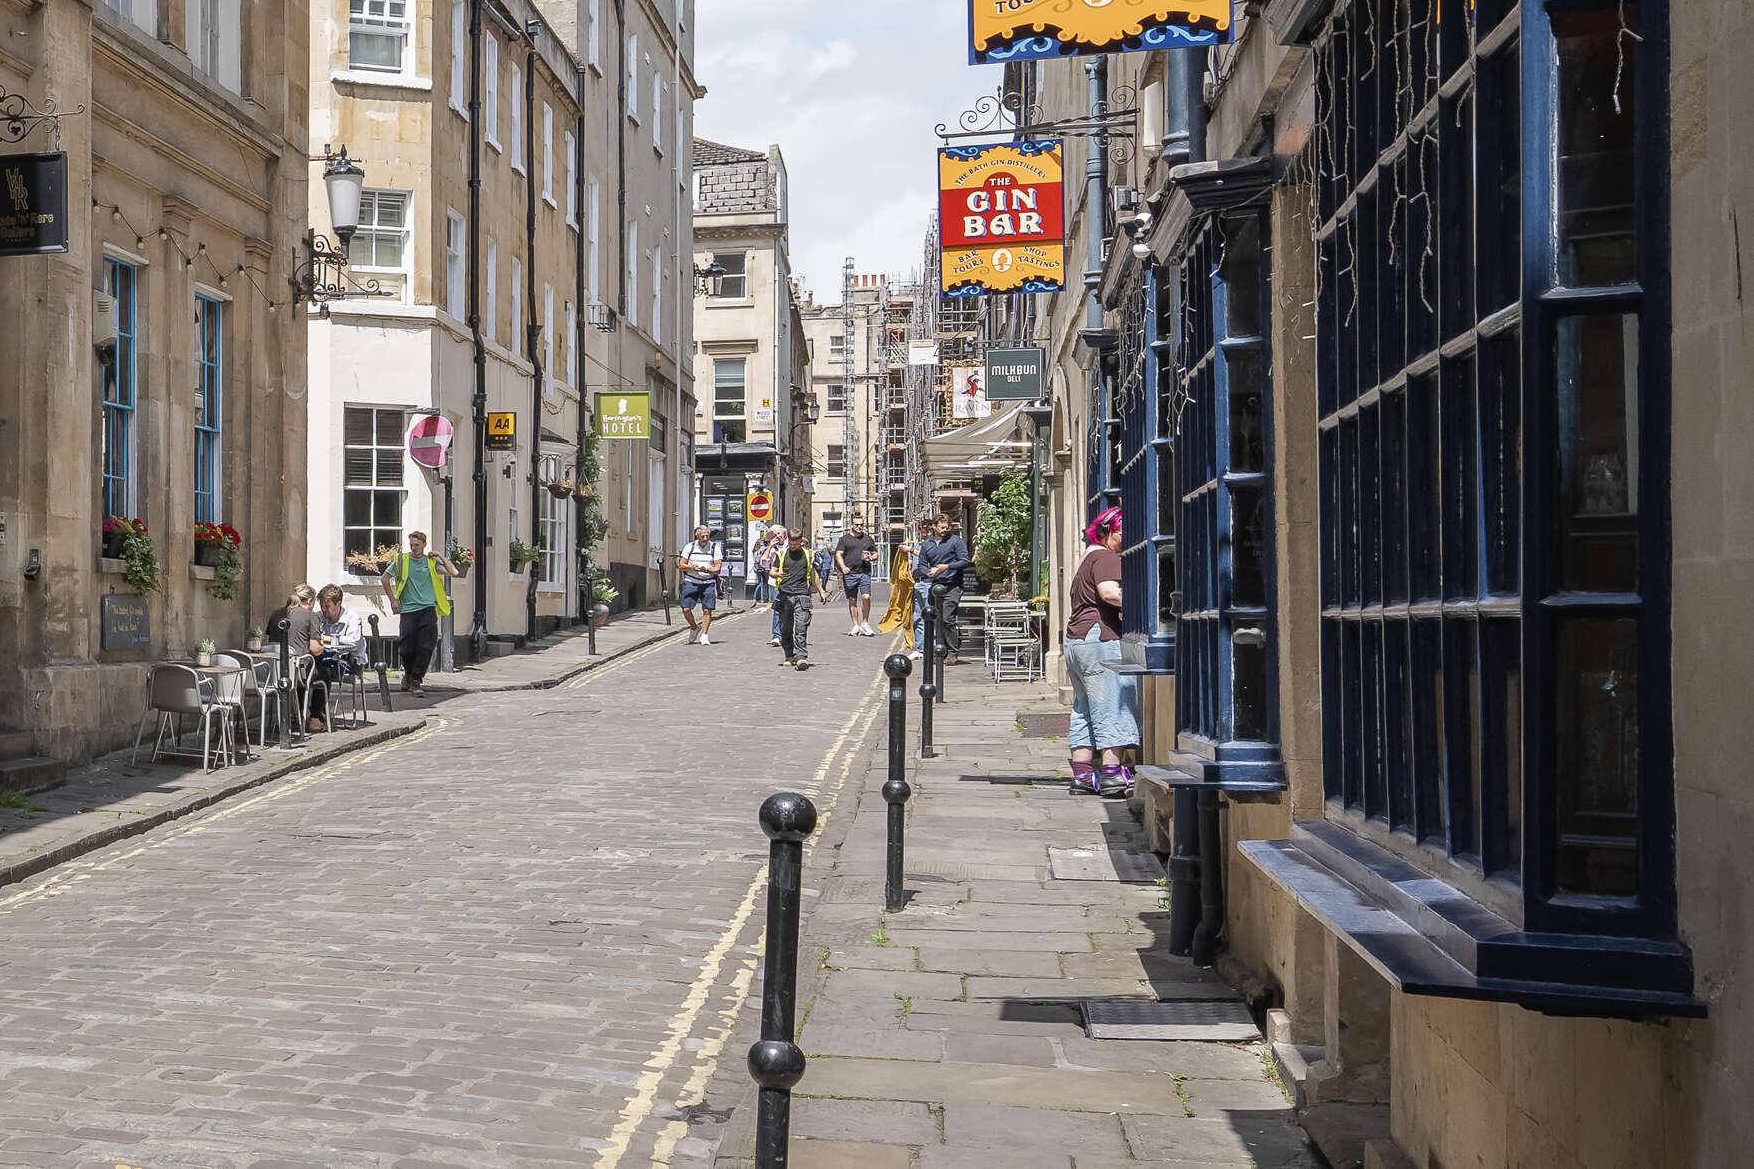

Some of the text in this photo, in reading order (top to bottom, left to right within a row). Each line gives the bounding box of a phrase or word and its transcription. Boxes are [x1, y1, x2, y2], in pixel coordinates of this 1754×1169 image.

[955, 159, 1046, 185] THE BATH GIN DISTILLERY
[990, 177, 1011, 187] THE
[966, 187, 1037, 213] GIN
[963, 212, 1043, 238] BAR
[958, 250, 979, 263] BAR
[1023, 246, 1047, 257] SHOP
[953, 258, 984, 274] TOURS
[1016, 256, 1060, 268] TASTINGS
[991, 365, 1037, 376] MILKBUN
[494, 418, 510, 430] AA
[603, 423, 643, 433] HOTEL
